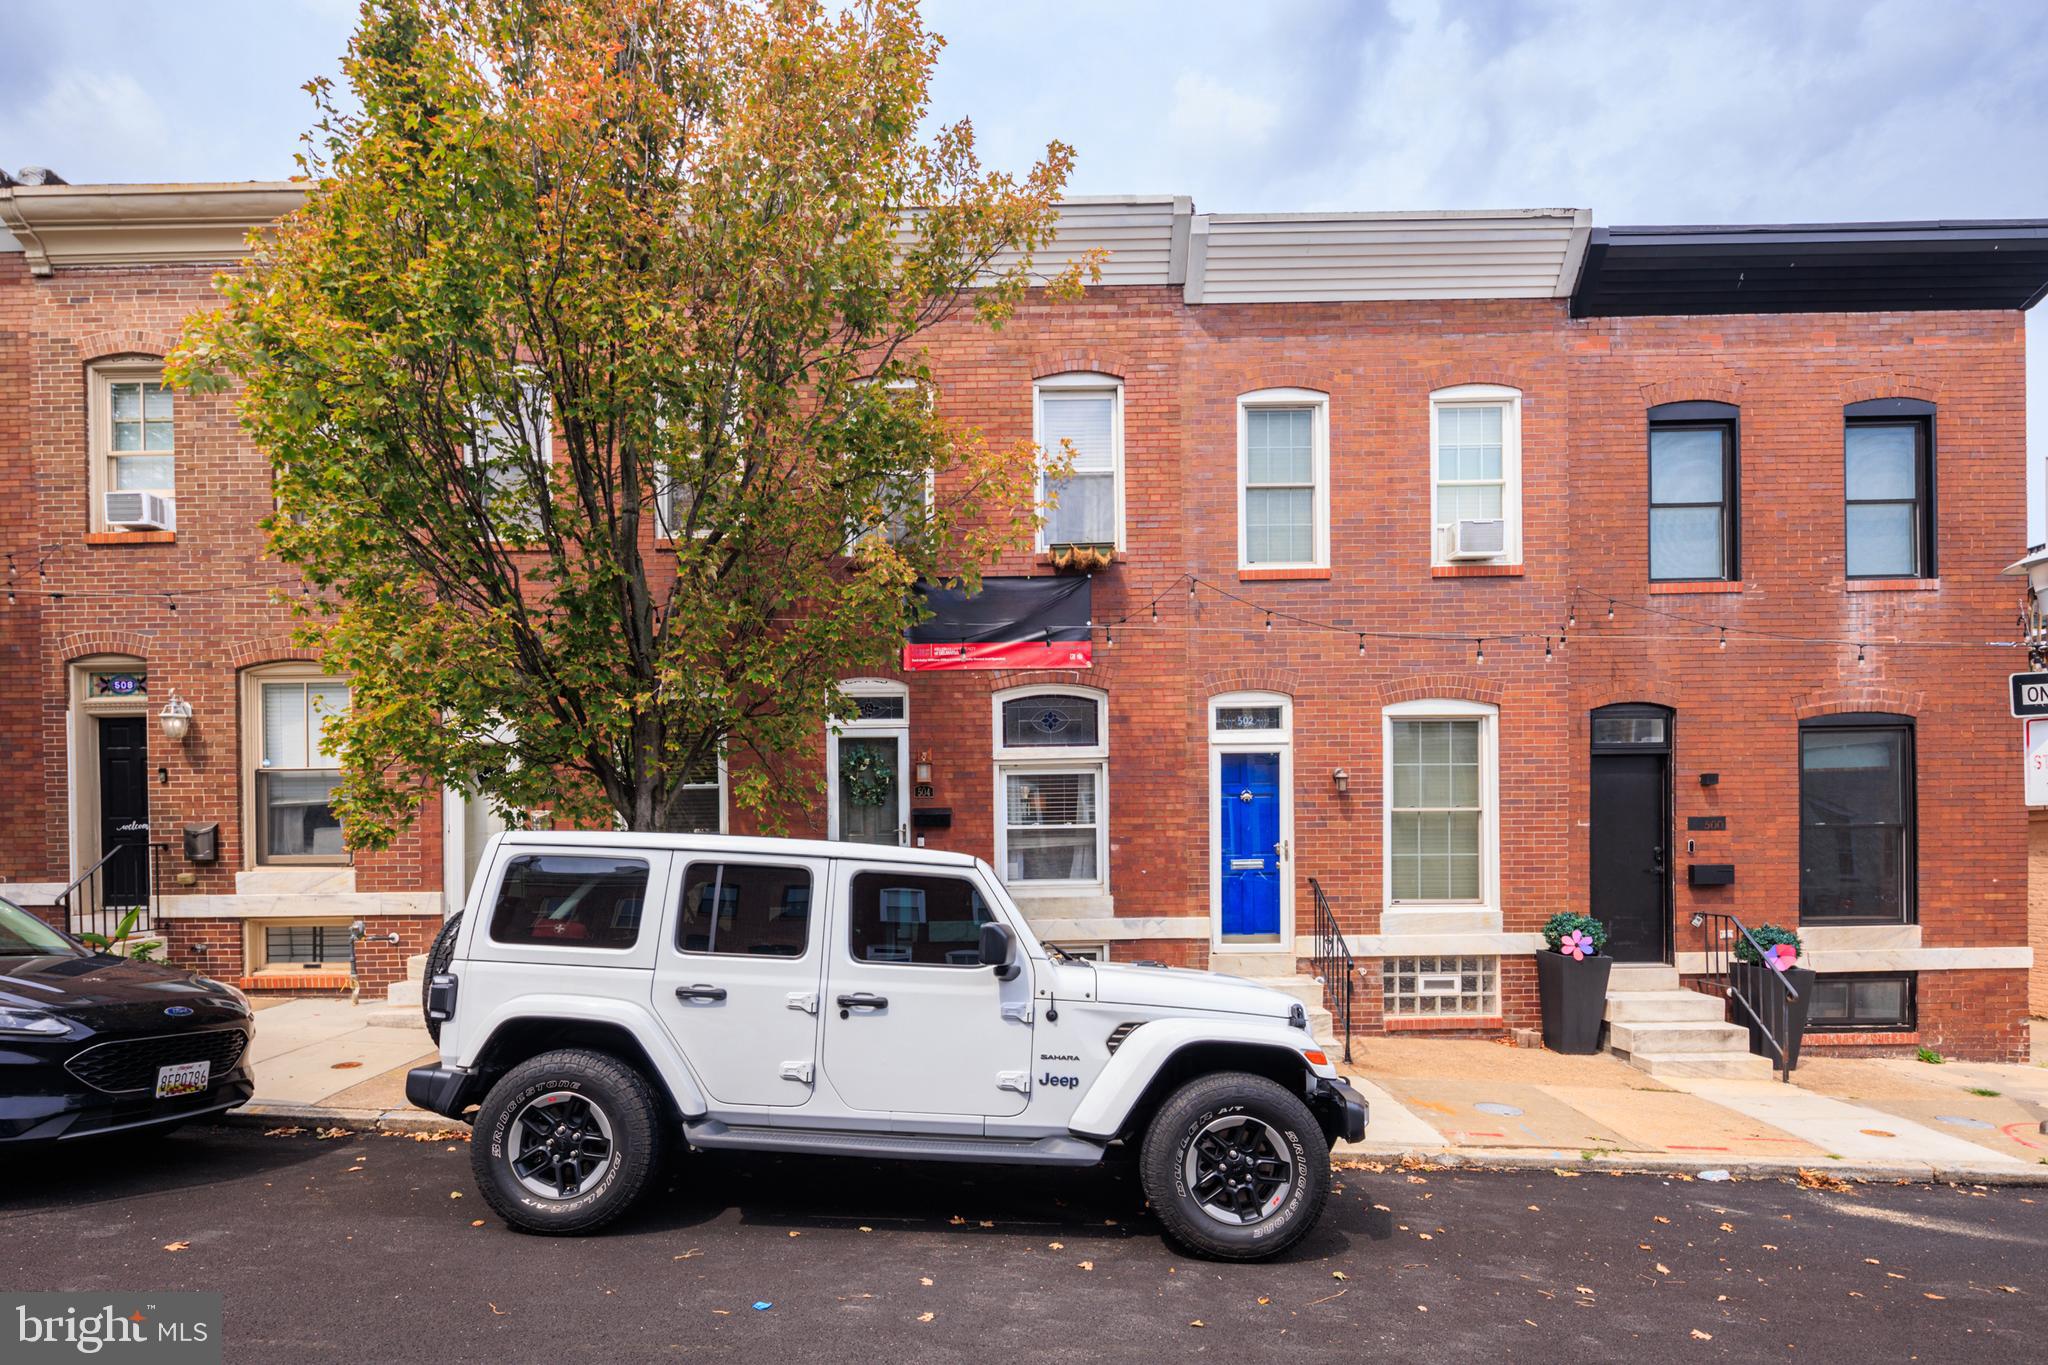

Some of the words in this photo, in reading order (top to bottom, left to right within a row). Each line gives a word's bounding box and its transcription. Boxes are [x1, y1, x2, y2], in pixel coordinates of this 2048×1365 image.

[114, 681, 133, 689] 508
[1237, 714, 1255, 726] 502
[1704, 820, 1724, 830] 500
[1038, 1072, 1079, 1090] Jeep
[491, 1079, 582, 1159] BRIDGESTONE
[1174, 1111, 1213, 1198] DUELER
[1252, 1130, 1308, 1239] BRIDGESTONE
